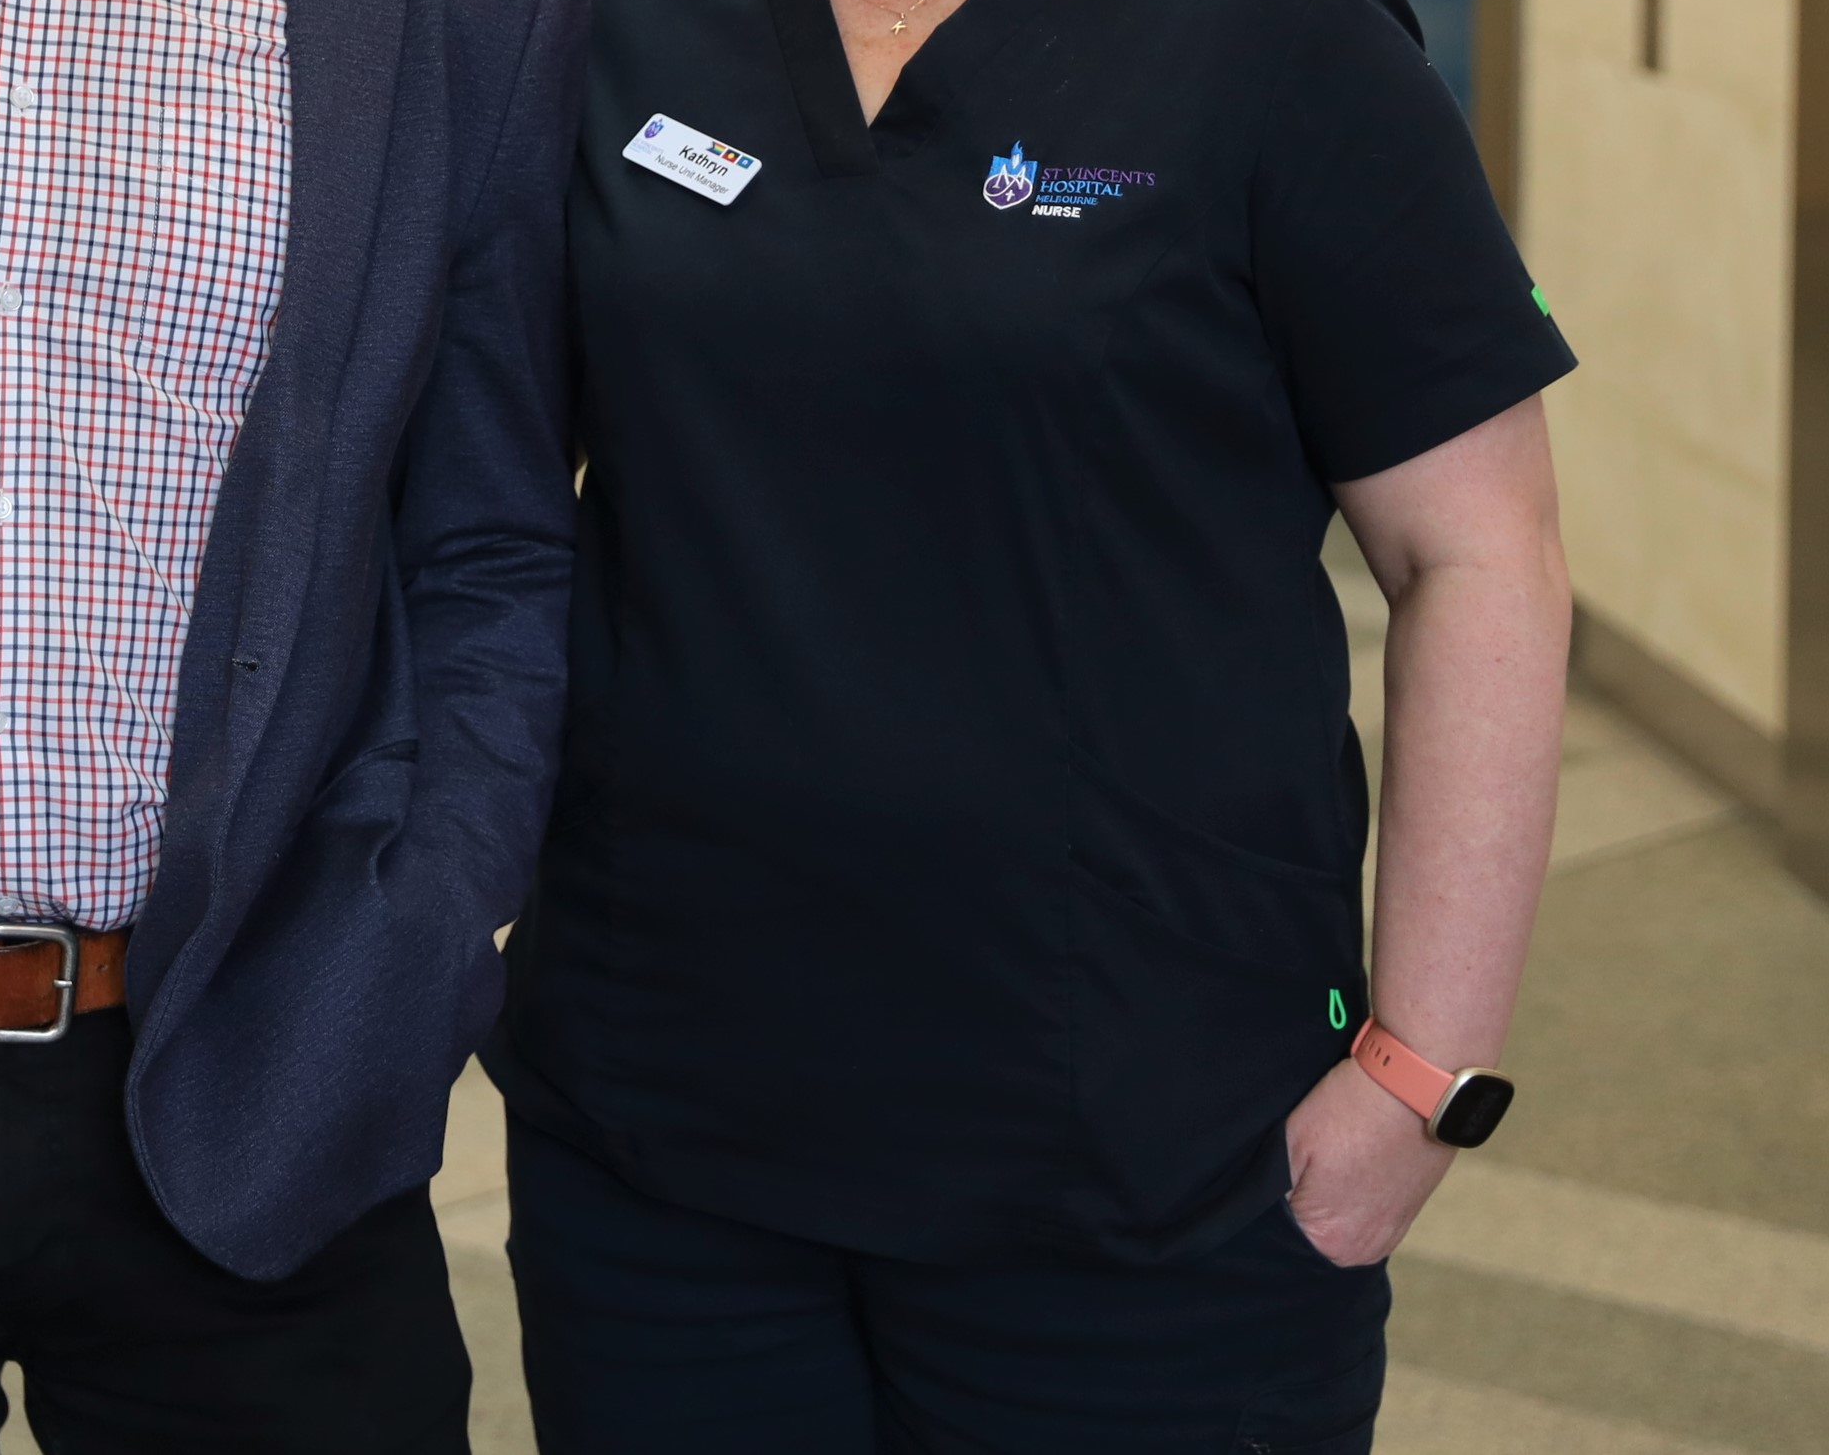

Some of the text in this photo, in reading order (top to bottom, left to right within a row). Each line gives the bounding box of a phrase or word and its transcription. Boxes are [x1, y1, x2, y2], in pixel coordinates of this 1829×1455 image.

[678, 144, 728, 176] Kathryn
[655, 154, 729, 194] Nurse Unit Manager
[1041, 167, 1156, 186] ST VINCENT'S
[1040, 180, 1123, 197] HOSPITAL
[1035, 195, 1098, 205] MELBOURNE
[1031, 204, 1081, 219] NURSE
